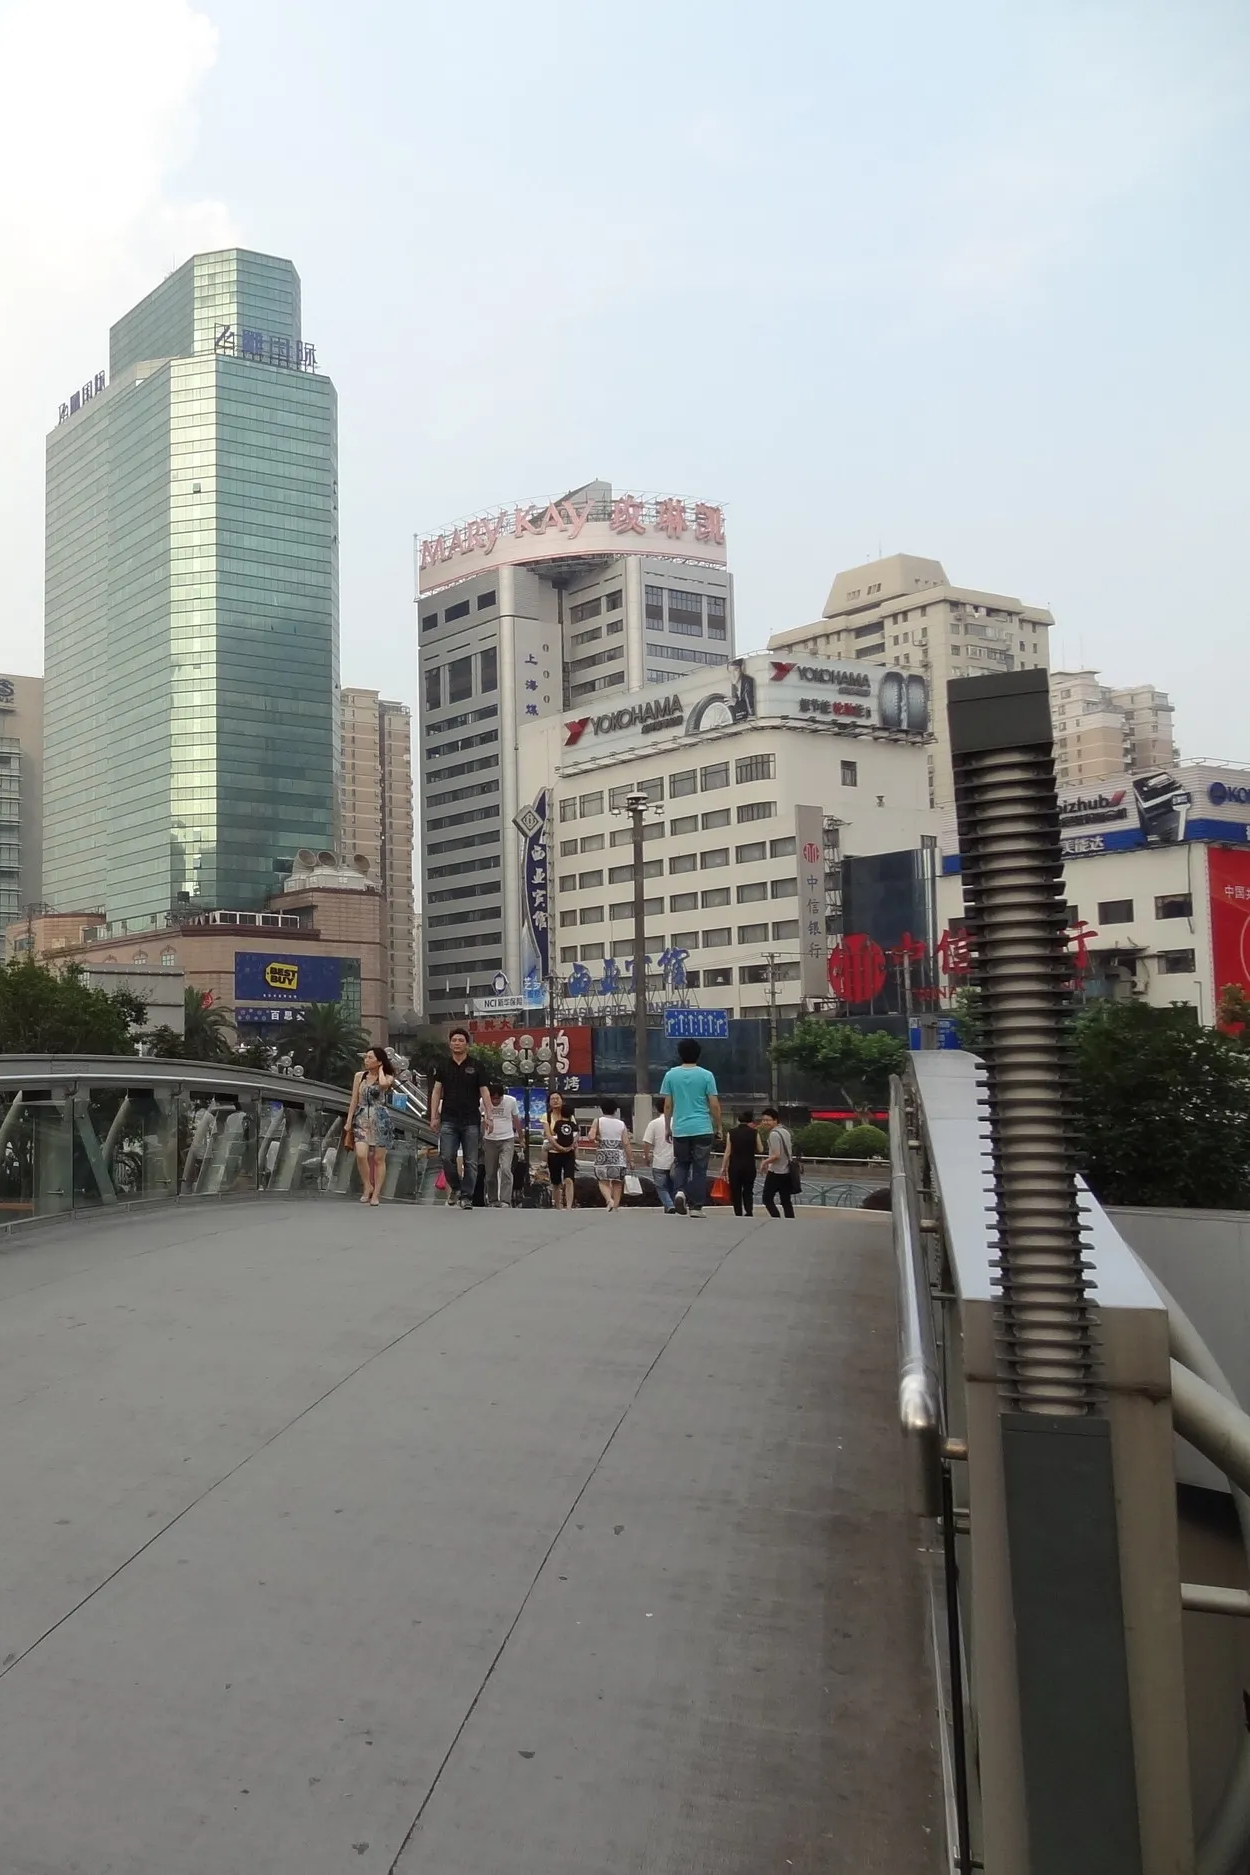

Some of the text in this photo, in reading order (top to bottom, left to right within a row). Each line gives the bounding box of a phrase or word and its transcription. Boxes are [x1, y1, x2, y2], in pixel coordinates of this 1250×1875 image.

[418, 499, 596, 571] MARY KAY
[796, 665, 871, 689] YOKOHAMA
[590, 693, 684, 736] YOKOHAMA
[1228, 786, 1250, 805] KO
[531, 845, 549, 931] 西亚宾馆
[806, 874, 822, 960] 中信银行
[270, 966, 298, 979] BEST
[270, 975, 295, 986] BUY
